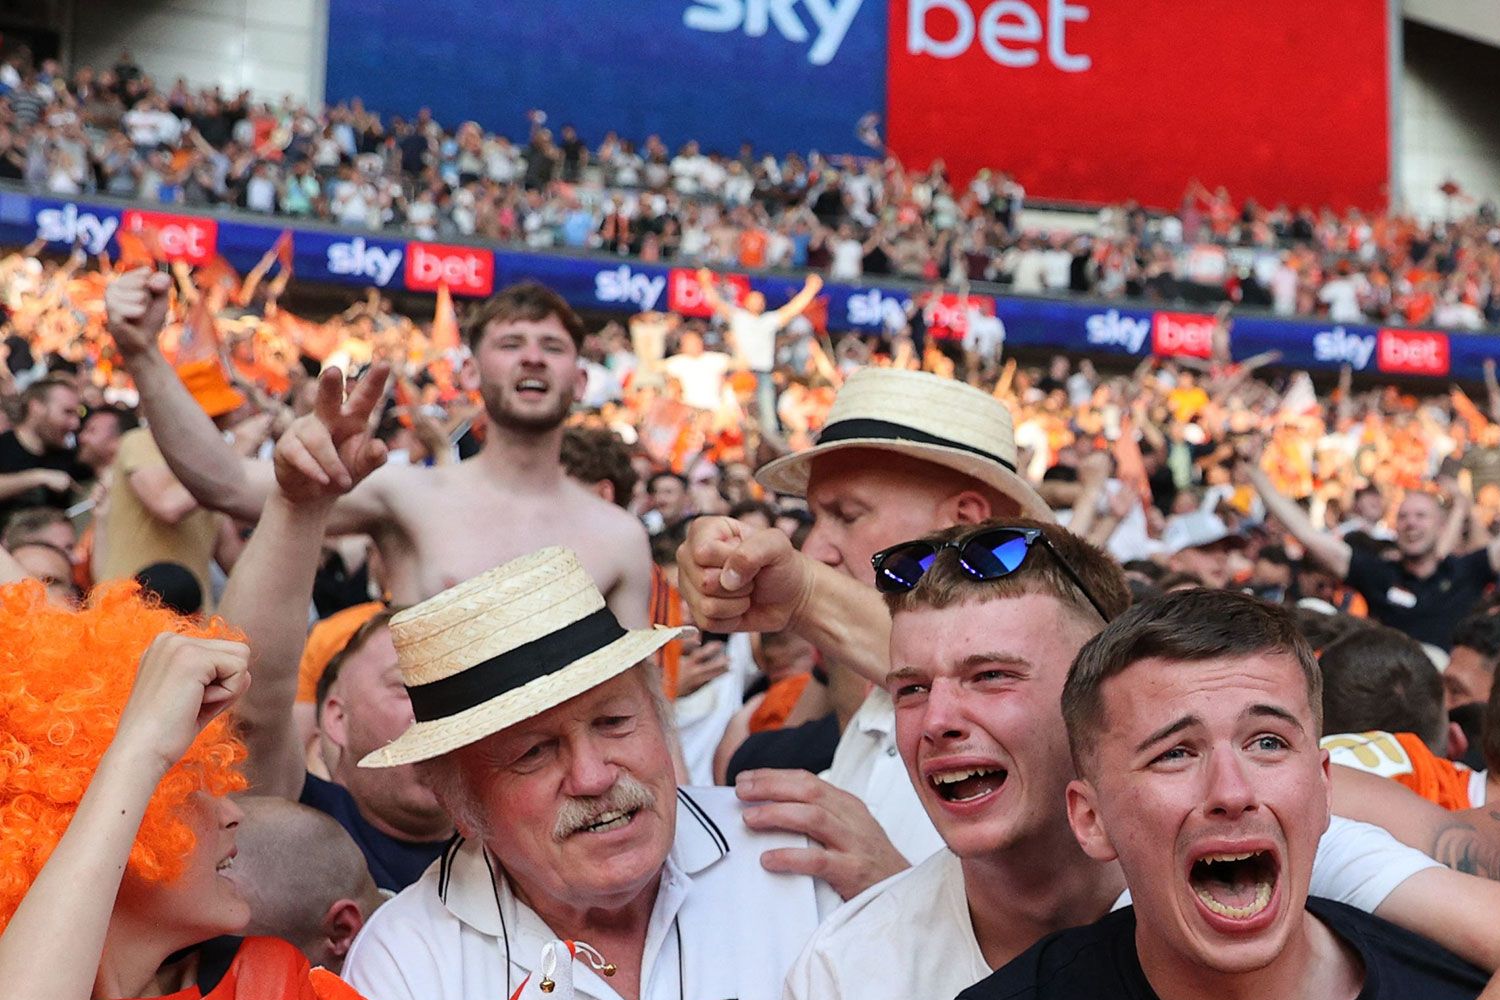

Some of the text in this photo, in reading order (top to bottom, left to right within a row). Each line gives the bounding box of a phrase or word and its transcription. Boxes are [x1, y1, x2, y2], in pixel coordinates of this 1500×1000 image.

[36, 203, 118, 254] sky
[327, 237, 484, 288] sky bet
[595, 264, 665, 311] sky
[1086, 308, 1149, 354] sky
[1313, 325, 1443, 370] sky bet
